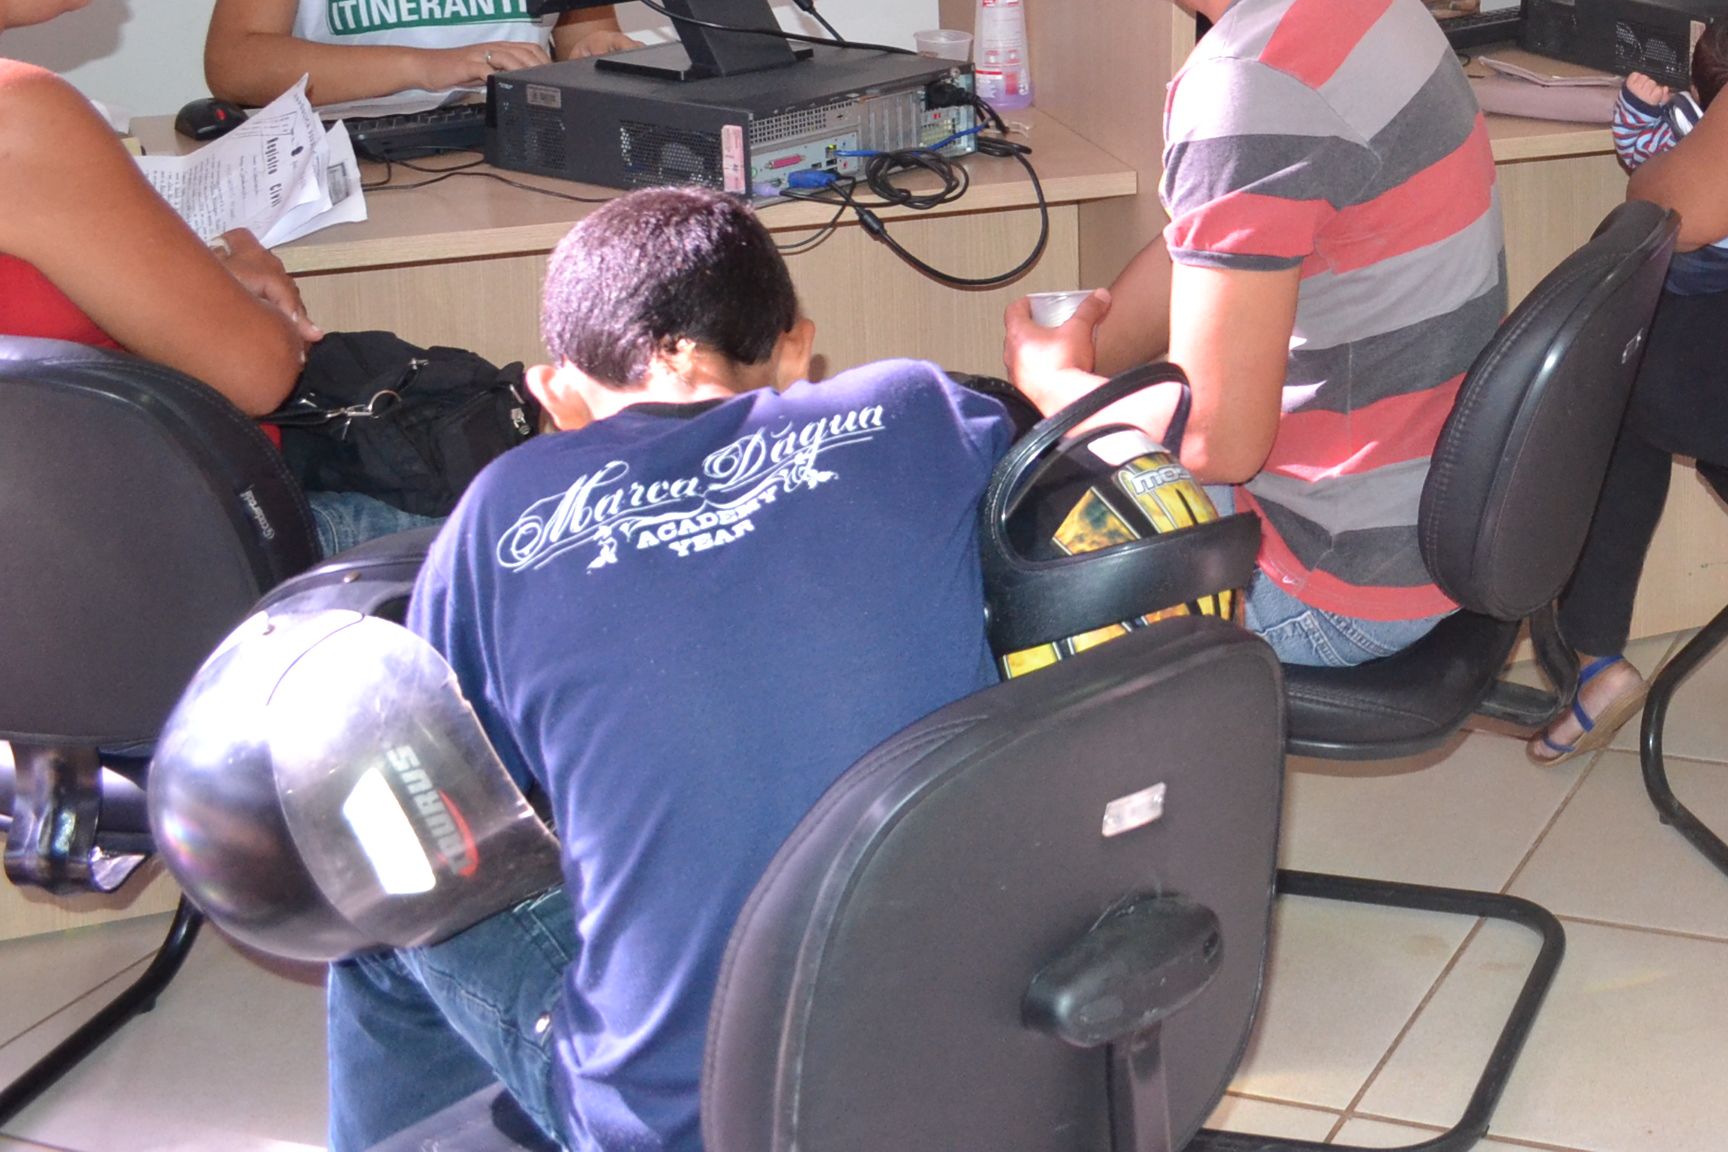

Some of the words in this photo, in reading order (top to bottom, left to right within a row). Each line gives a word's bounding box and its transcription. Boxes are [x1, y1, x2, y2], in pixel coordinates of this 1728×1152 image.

[497, 460, 699, 569] Marca
[636, 485, 778, 550] ACADEMY
[668, 519, 755, 558] YEAR
[386, 745, 473, 876] TAURUS
